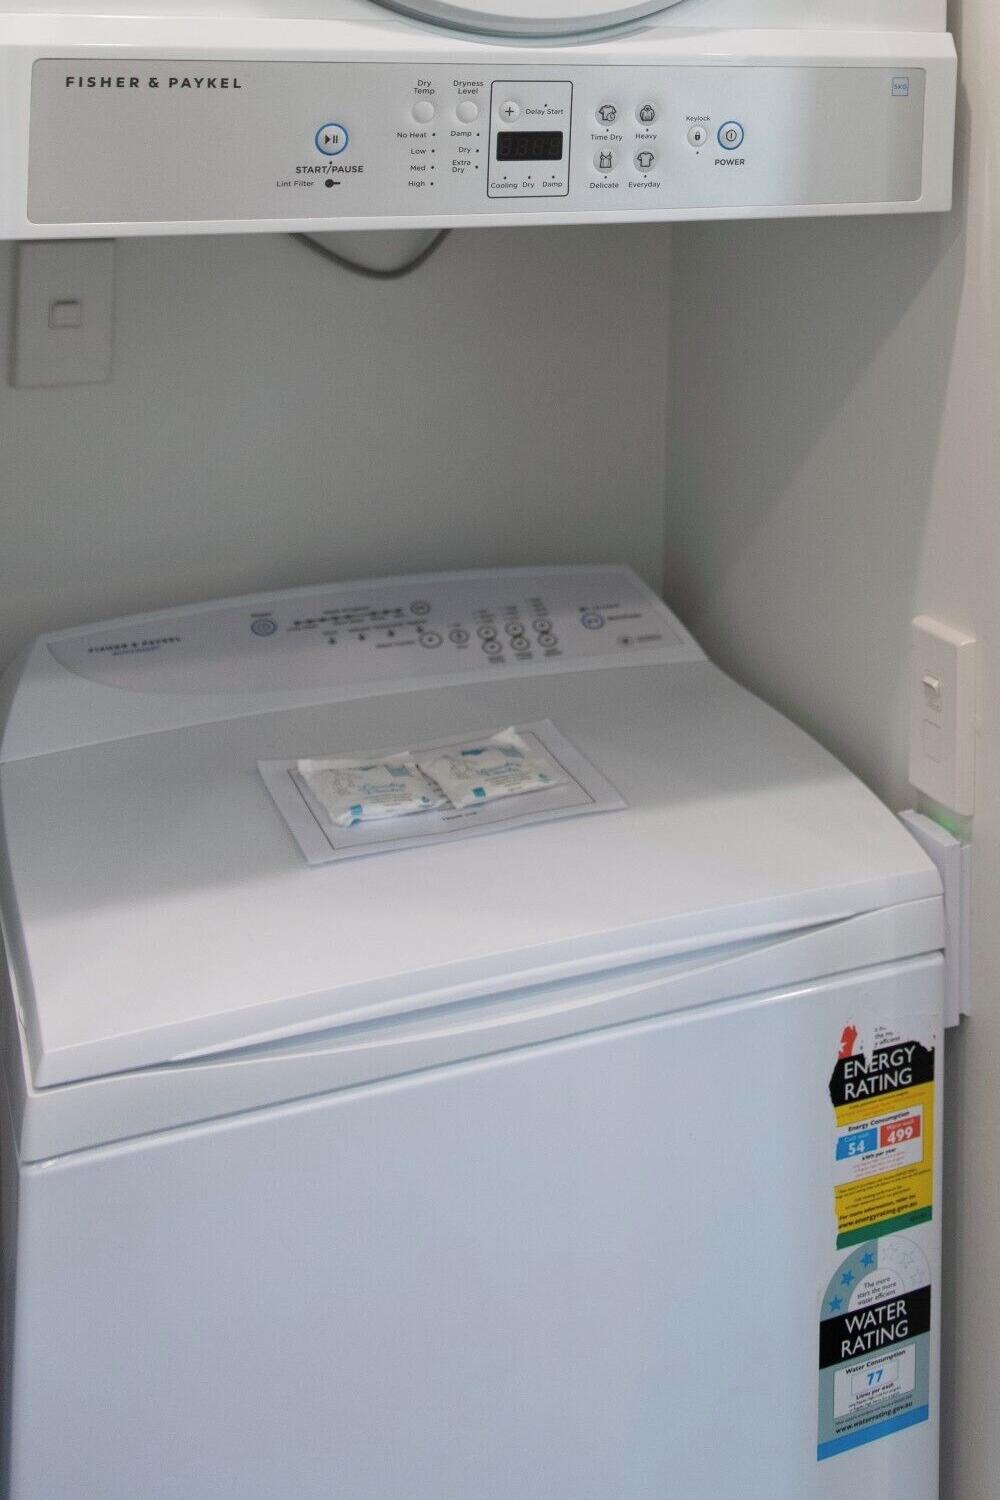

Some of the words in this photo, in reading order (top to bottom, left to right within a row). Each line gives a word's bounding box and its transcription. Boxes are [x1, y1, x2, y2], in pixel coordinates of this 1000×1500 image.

[65, 76, 140, 88] FISHER
[148, 77, 160, 88] &
[168, 77, 242, 89] PAYKEL
[417, 80, 432, 88] Dry
[453, 80, 484, 88] Dryness
[413, 88, 435, 96] Temp
[458, 87, 478, 95] Level
[525, 108, 546, 116] Delay
[686, 115, 711, 123] Keylock
[609, 134, 623, 142] Dry
[635, 133, 657, 141] Heavy
[458, 146, 471, 154] Dry
[715, 158, 745, 166] POWER
[295, 165, 364, 174] START/PAUSE
[452, 166, 465, 174] Dry
[408, 180, 425, 188] High
[628, 181, 661, 189] Everyday
[844, 1045, 916, 1080] ENERGY
[844, 1068, 912, 1101] RATING
[848, 1122, 869, 1132] Energy
[887, 1126, 914, 1143] 499
[848, 1140, 865, 1156] 54
[845, 1300, 907, 1334] WATER
[841, 1320, 908, 1358] RATING
[845, 1364, 865, 1375] Water
[866, 1349, 906, 1367] Consumption
[867, 1369, 883, 1386] 77
[835, 1401, 913, 1434] www.waterrating.gov.au
